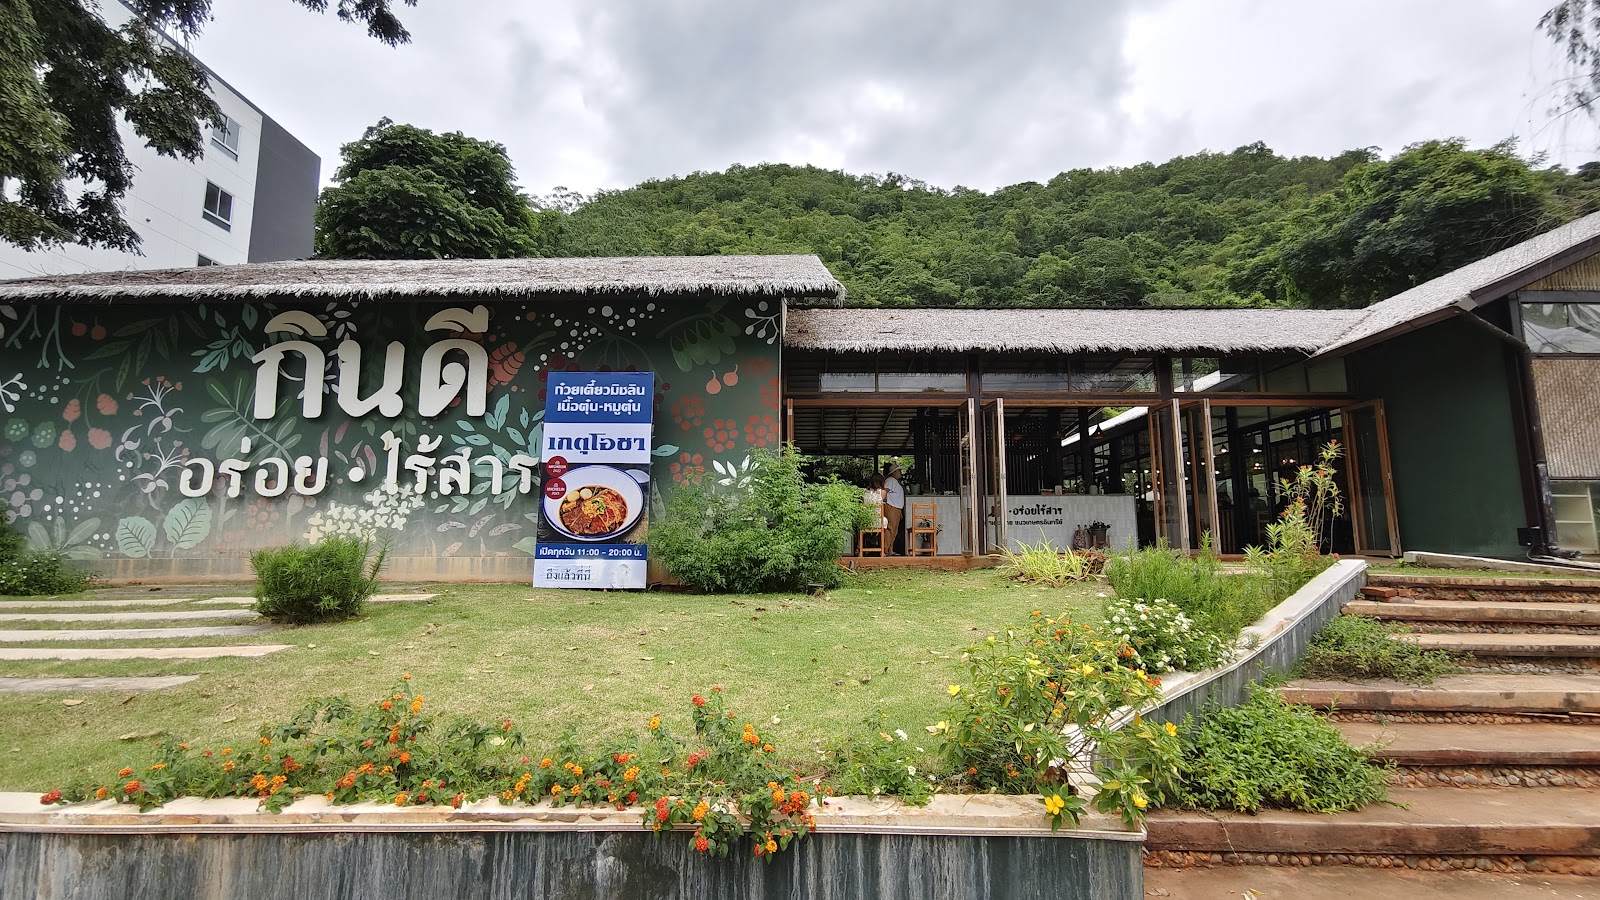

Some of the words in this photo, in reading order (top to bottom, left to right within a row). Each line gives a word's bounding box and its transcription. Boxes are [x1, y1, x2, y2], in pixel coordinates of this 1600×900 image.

[251, 305, 489, 420] กินดี
[554, 379, 646, 396] ก๋วยเตี๋ยวมิชลิน
[557, 396, 641, 415] เนื้อตุ๋น-หมูตุ๋น
[179, 436, 329, 498] อร่อย
[380, 430, 540, 496] ไร้สาร
[539, 547, 575, 559] เปิดทุกวัน
[577, 548, 600, 556] 11:00
[608, 548, 632, 556] 20:00
